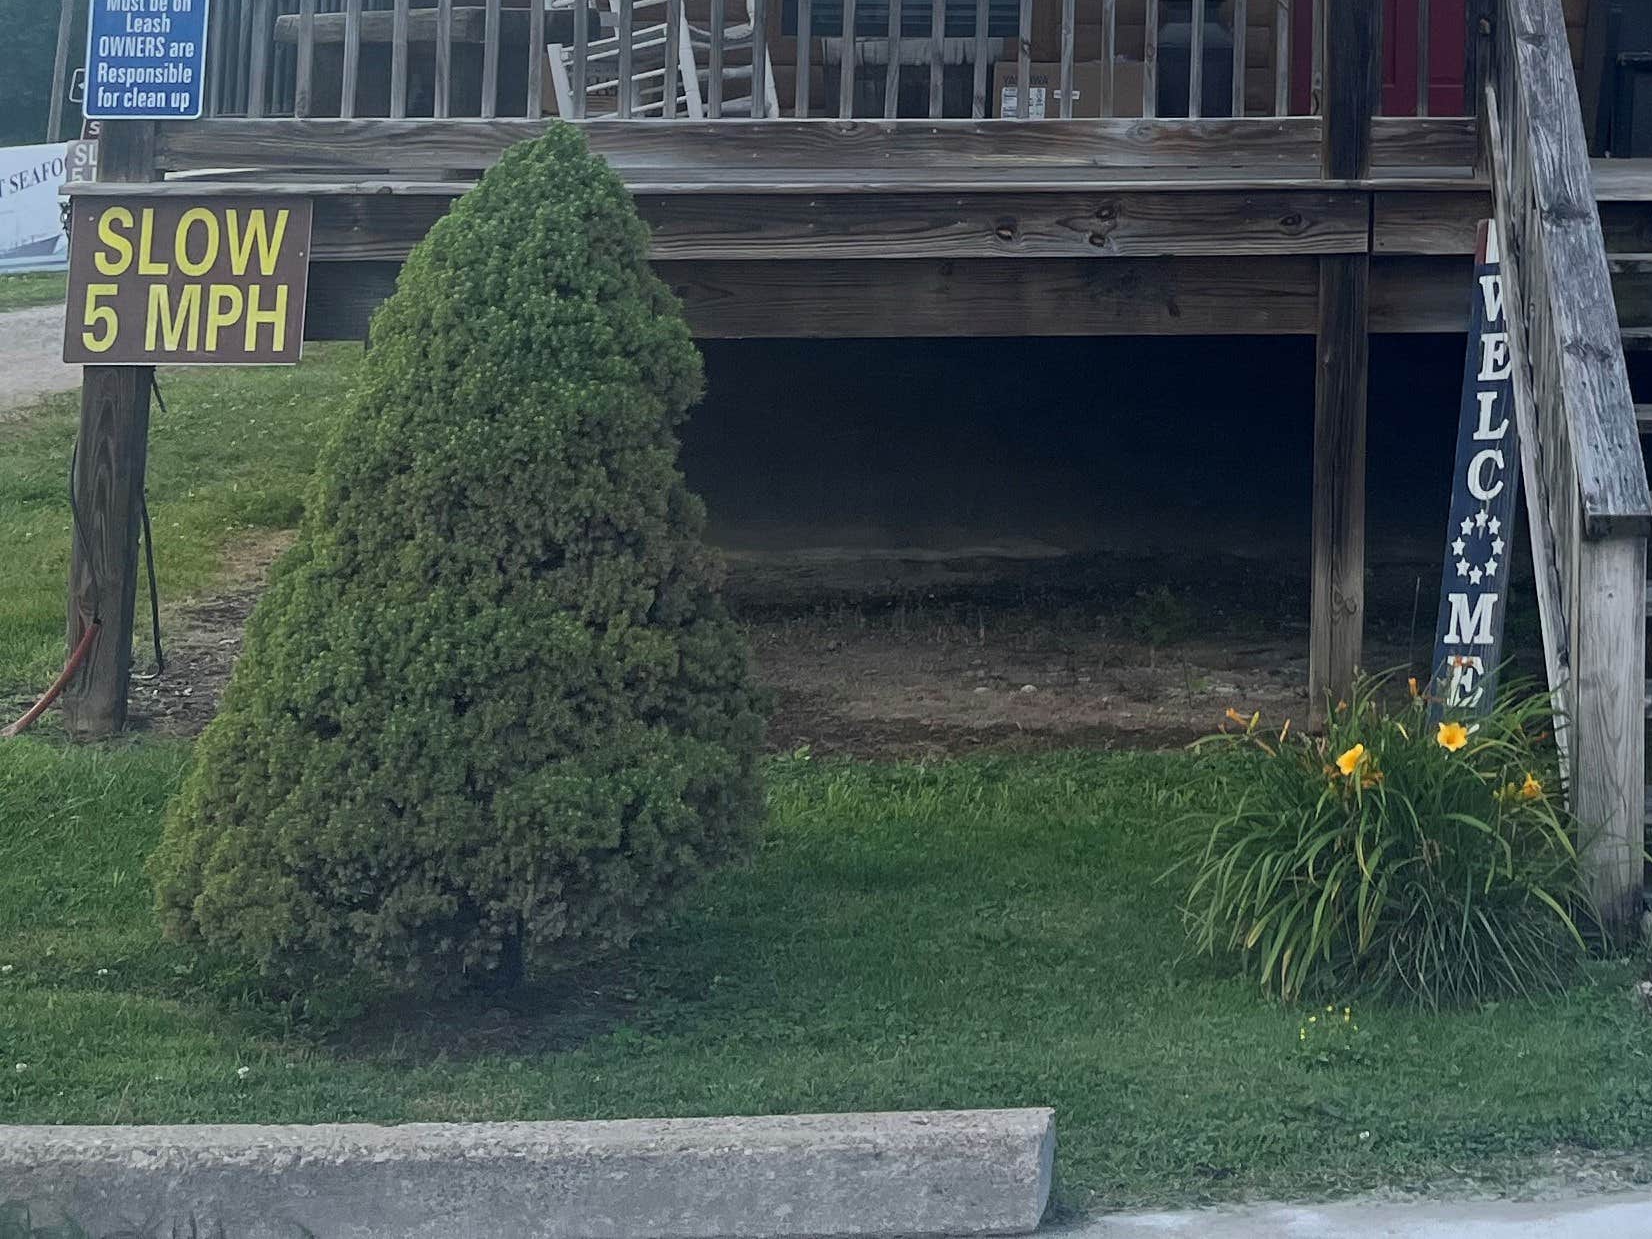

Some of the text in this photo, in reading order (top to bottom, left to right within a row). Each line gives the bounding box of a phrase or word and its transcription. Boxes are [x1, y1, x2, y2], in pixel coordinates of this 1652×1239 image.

[126, 12, 171, 33] Leash
[99, 36, 195, 58] OWNERS are
[97, 62, 192, 87] Responsible
[97, 87, 190, 112] for clean up
[74, 143, 98, 166] SL
[9, 156, 68, 194] SEAFO
[94, 206, 290, 277] SLOW
[82, 283, 289, 353] 5 MPH
